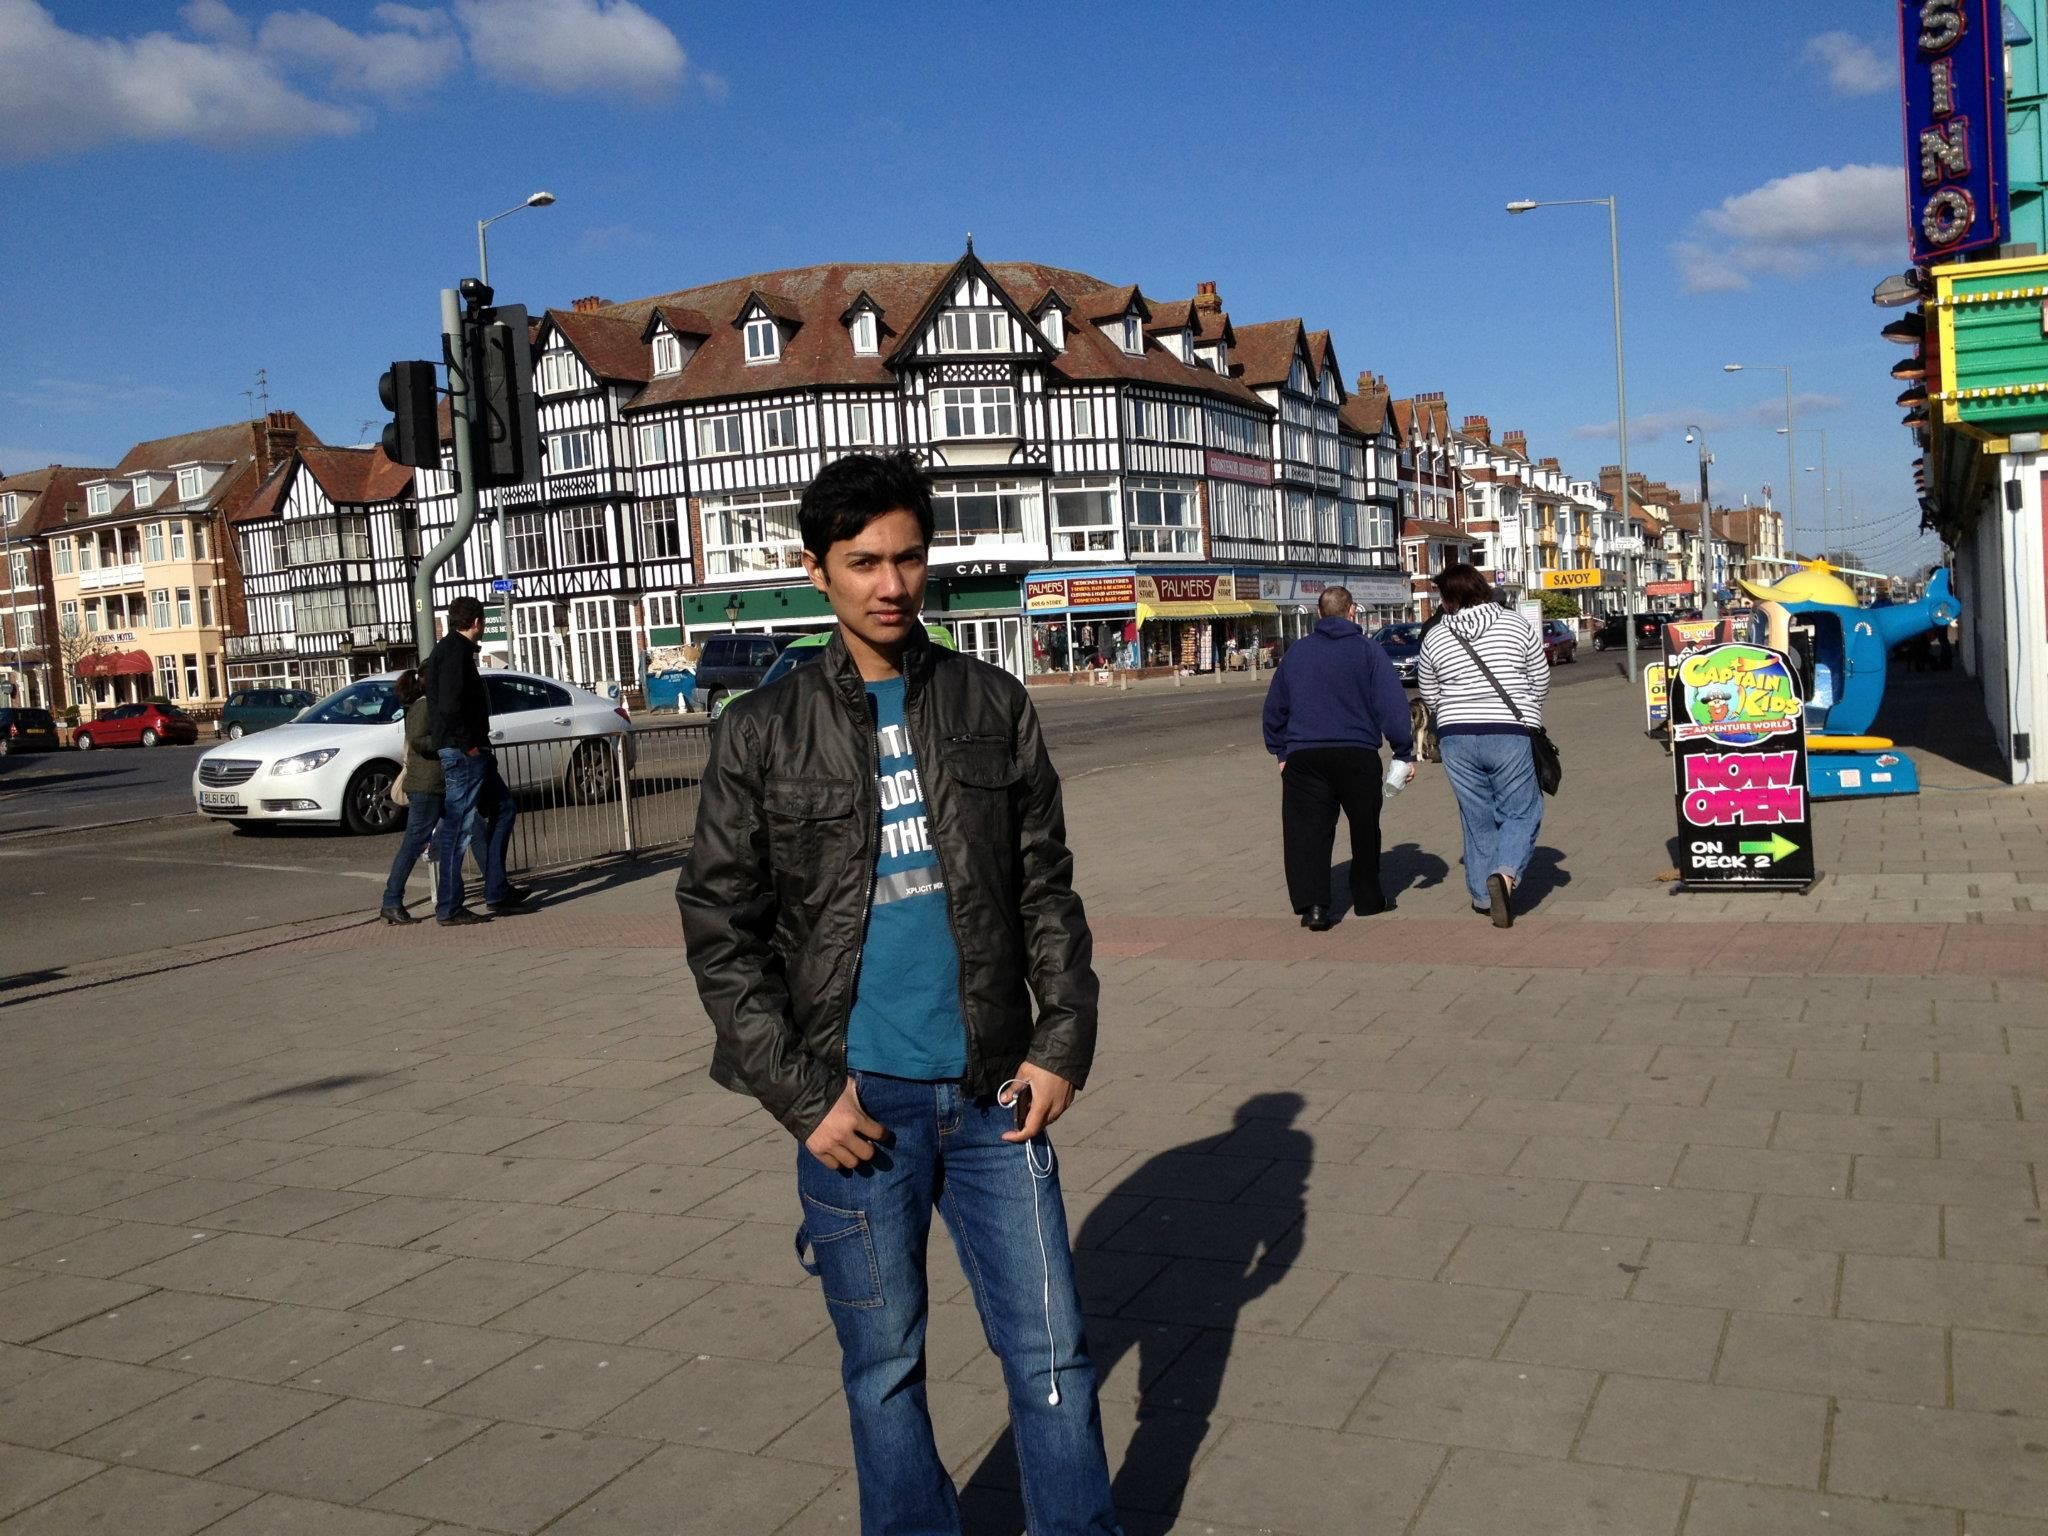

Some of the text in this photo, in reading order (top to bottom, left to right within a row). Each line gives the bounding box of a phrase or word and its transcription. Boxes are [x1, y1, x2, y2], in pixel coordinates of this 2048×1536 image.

[956, 563, 1007, 574] CAFE
[1553, 573, 1590, 585] SAVOY
[1028, 582, 1064, 594] PALMERS
[1139, 590, 1155, 598] STORE
[1161, 579, 1212, 597] PALMERS
[1218, 589, 1231, 597] STORE
[116, 632, 135, 641] HOTEL
[1694, 720, 1790, 734] ADVENTURE WORLD
[1684, 750, 1798, 792] NOW
[1682, 785, 1804, 826] OPEN
[882, 816, 933, 859] THE
[1691, 841, 1723, 854] ON
[1692, 855, 1771, 868] DECK 2
